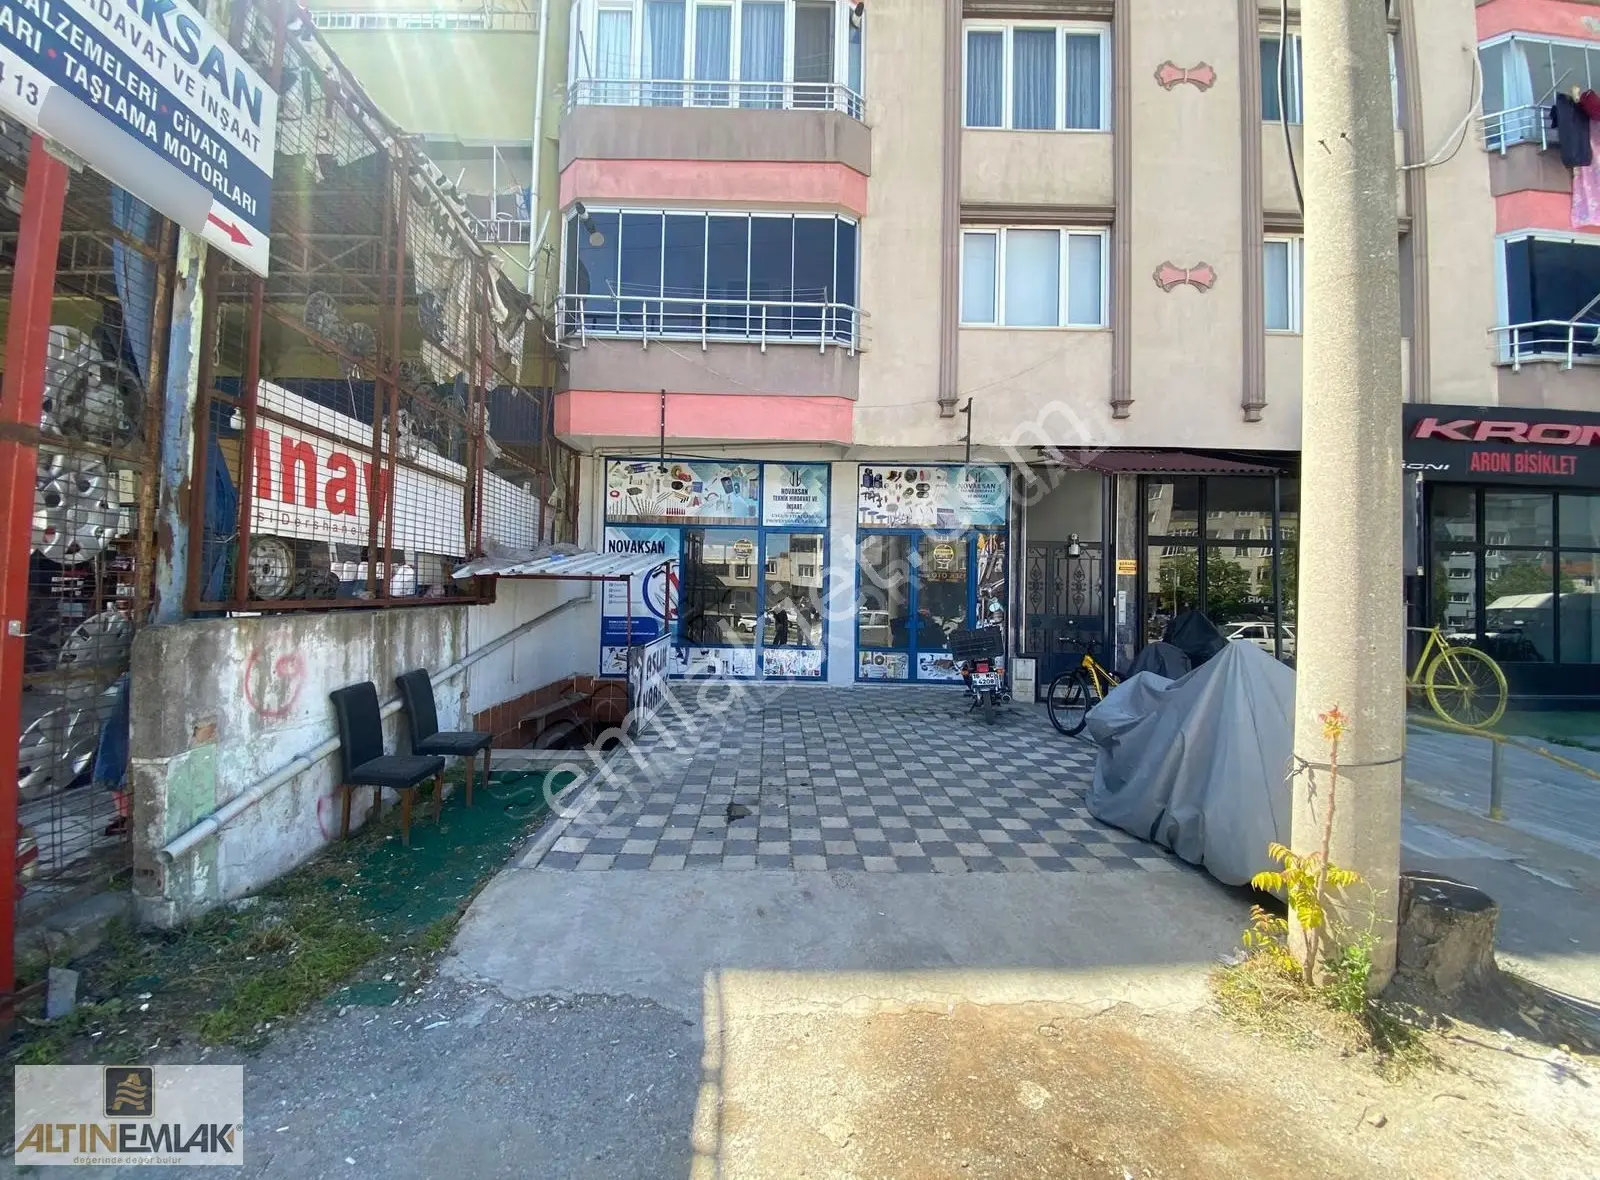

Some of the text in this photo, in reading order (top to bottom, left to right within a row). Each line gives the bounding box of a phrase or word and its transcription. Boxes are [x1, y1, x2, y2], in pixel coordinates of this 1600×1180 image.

[17, 0, 229, 170] ALZEMELERİ CİVATA
[63, 51, 158, 144] TAŞLAMA
[163, 131, 257, 217] MOTORLARI
[89, 0, 261, 154] DAVAT VE İNŞAAT
[126, 0, 263, 128] KSAN
[1470, 450, 1578, 476] ARON BİSİKLET
[608, 539, 666, 554] NOVAKSAN
